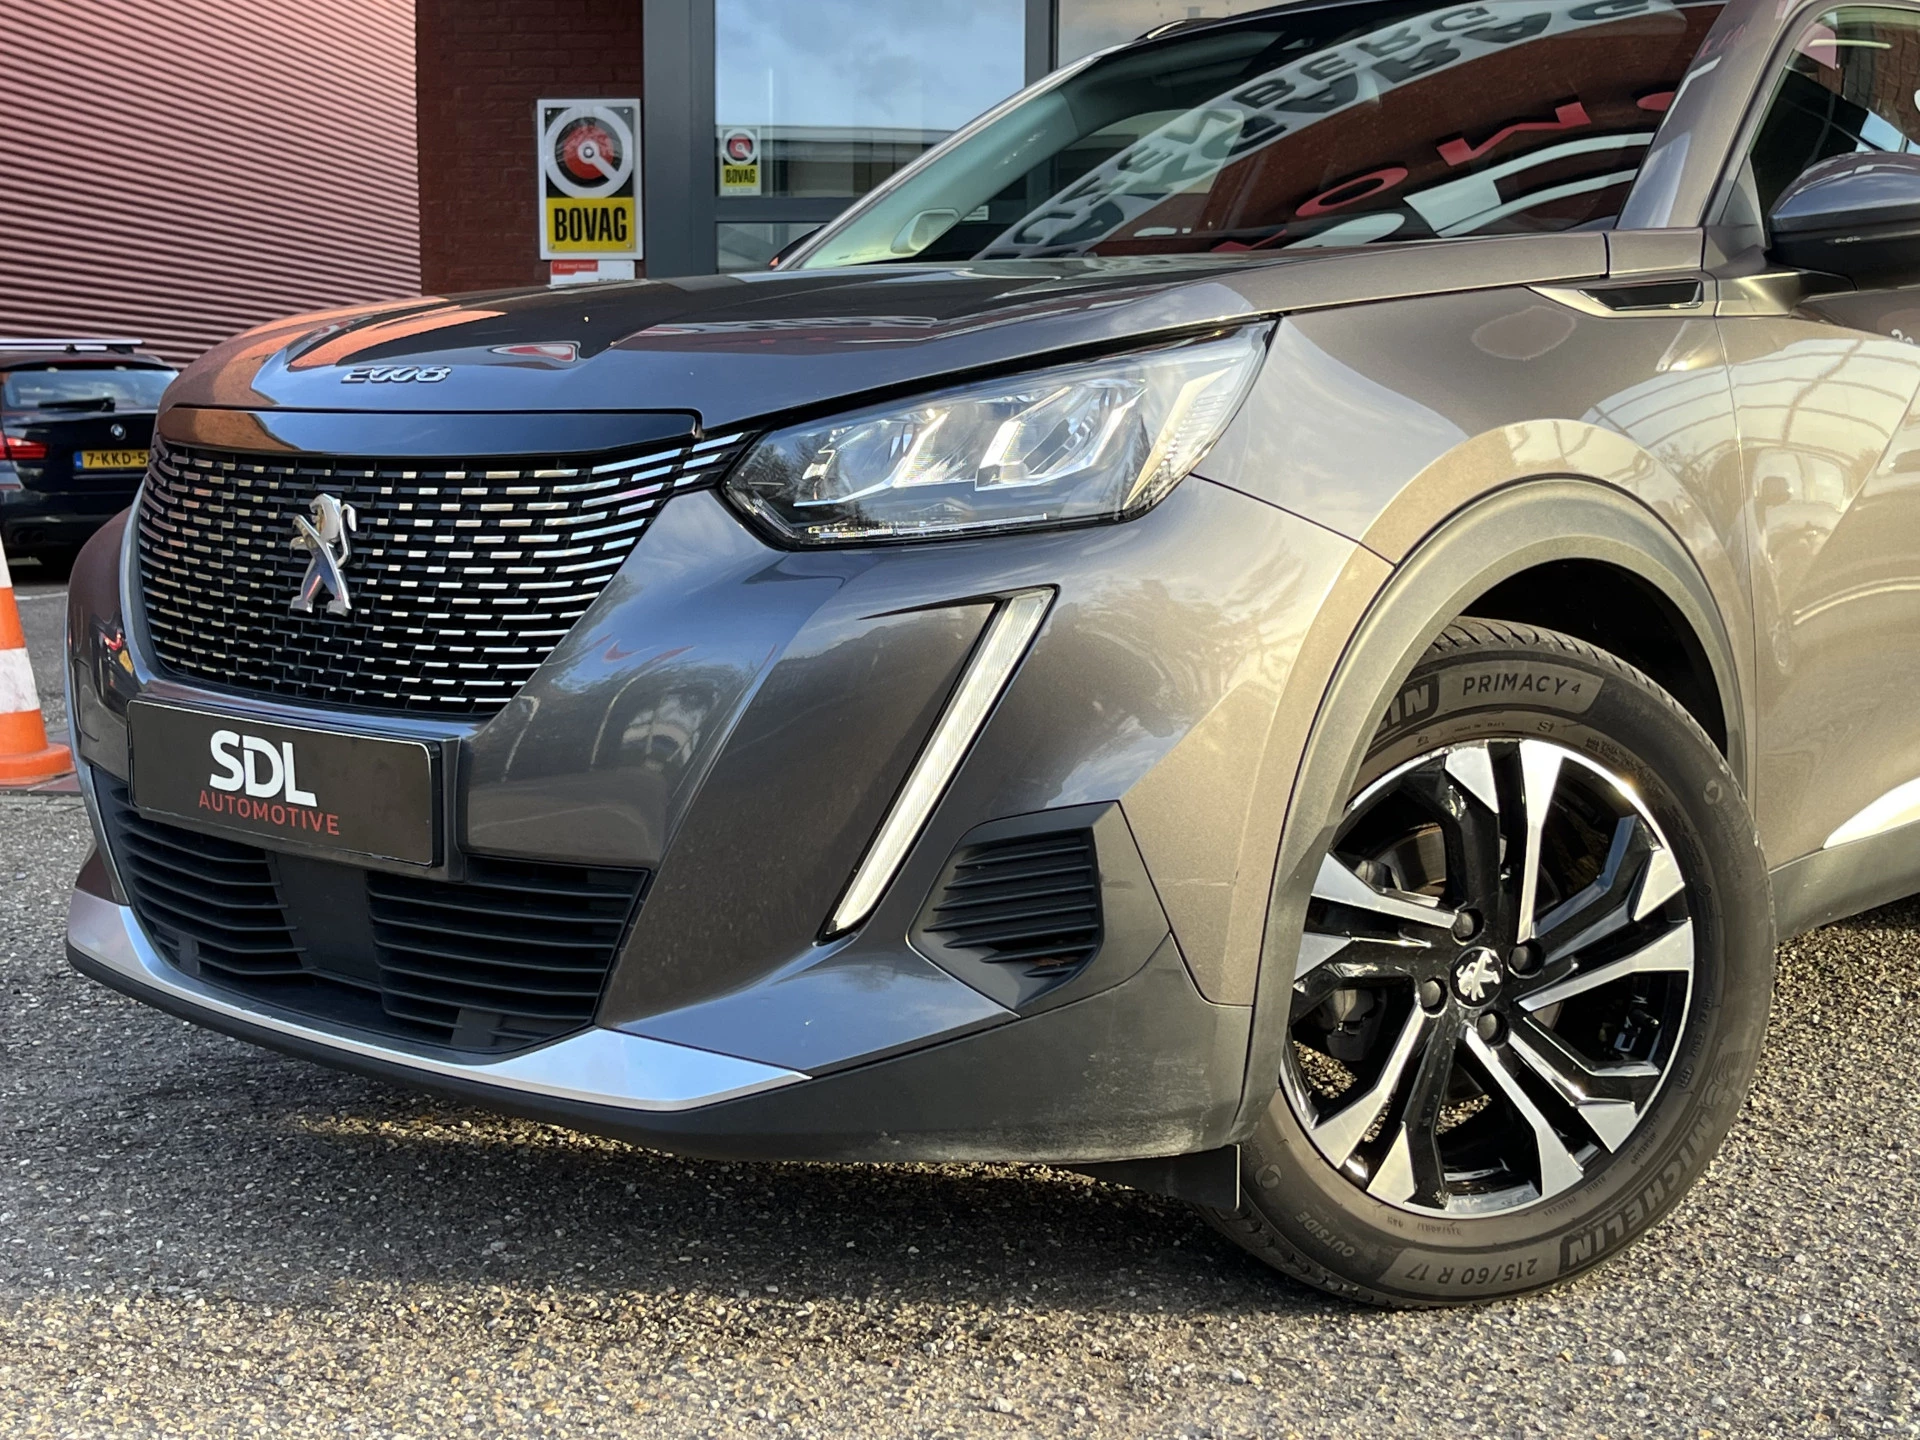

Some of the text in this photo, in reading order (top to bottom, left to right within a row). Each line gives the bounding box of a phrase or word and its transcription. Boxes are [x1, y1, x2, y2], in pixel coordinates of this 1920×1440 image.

[725, 169, 756, 183] BOVAG
[554, 207, 627, 242] BOVAG
[340, 366, 452, 383] 2008
[86, 452, 149, 466] 7-KKD-5
[1463, 673, 1581, 696] PRIMACY 4
[209, 730, 317, 807] SDL
[199, 790, 340, 836] AUTOMOTIVE
[1568, 1115, 1714, 1265] MICHELIN
[1296, 1211, 1355, 1257] OUTSIDE
[1406, 1258, 1538, 1285] 215/60 R 17
